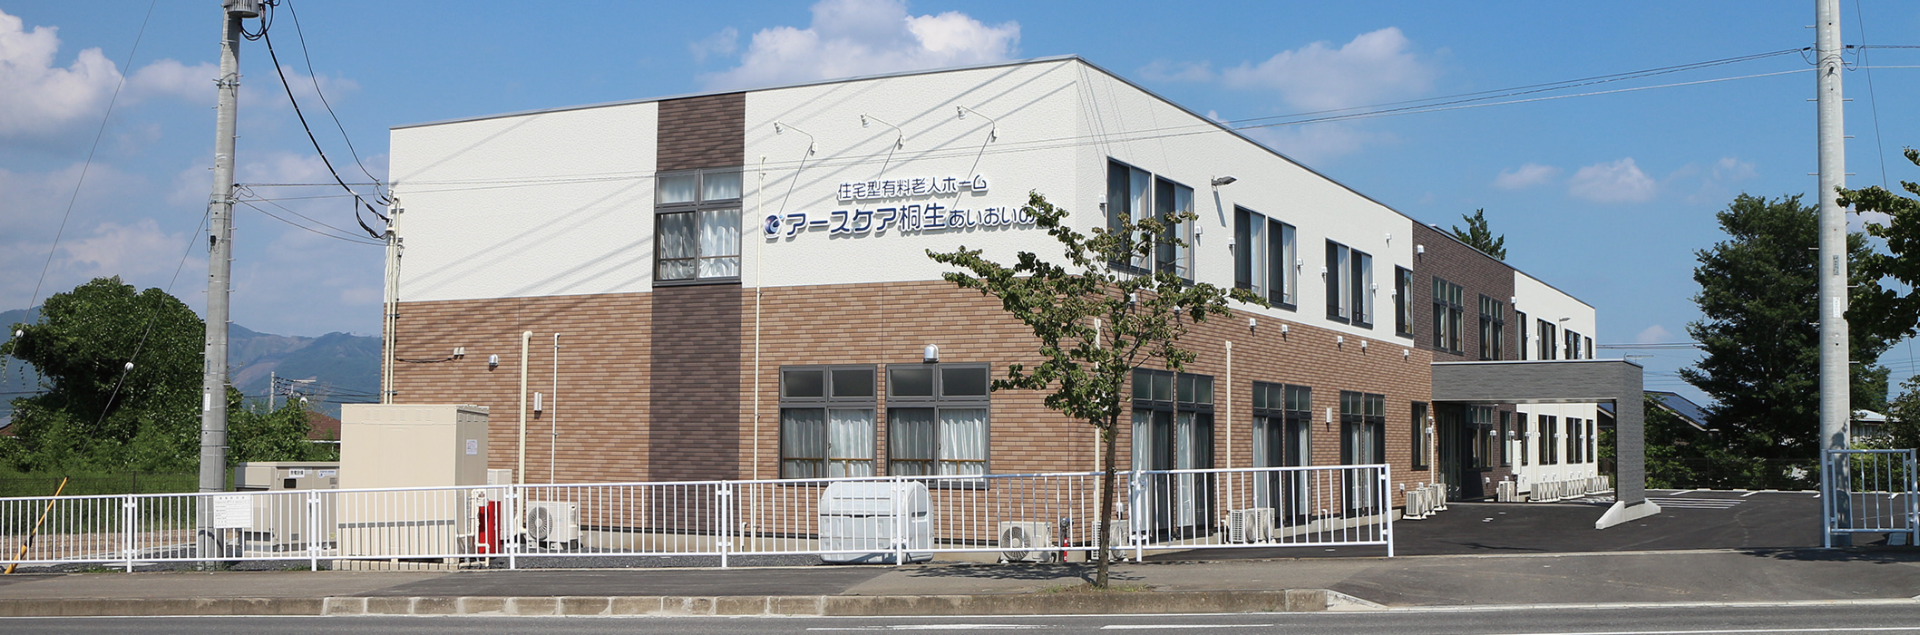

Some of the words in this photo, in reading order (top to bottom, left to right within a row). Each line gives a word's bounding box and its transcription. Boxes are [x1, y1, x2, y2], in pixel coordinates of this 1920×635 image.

[838, 174, 987, 200] 住宅型有料老人ホーム
[785, 203, 1049, 236] アースケア桐生あいおいの
